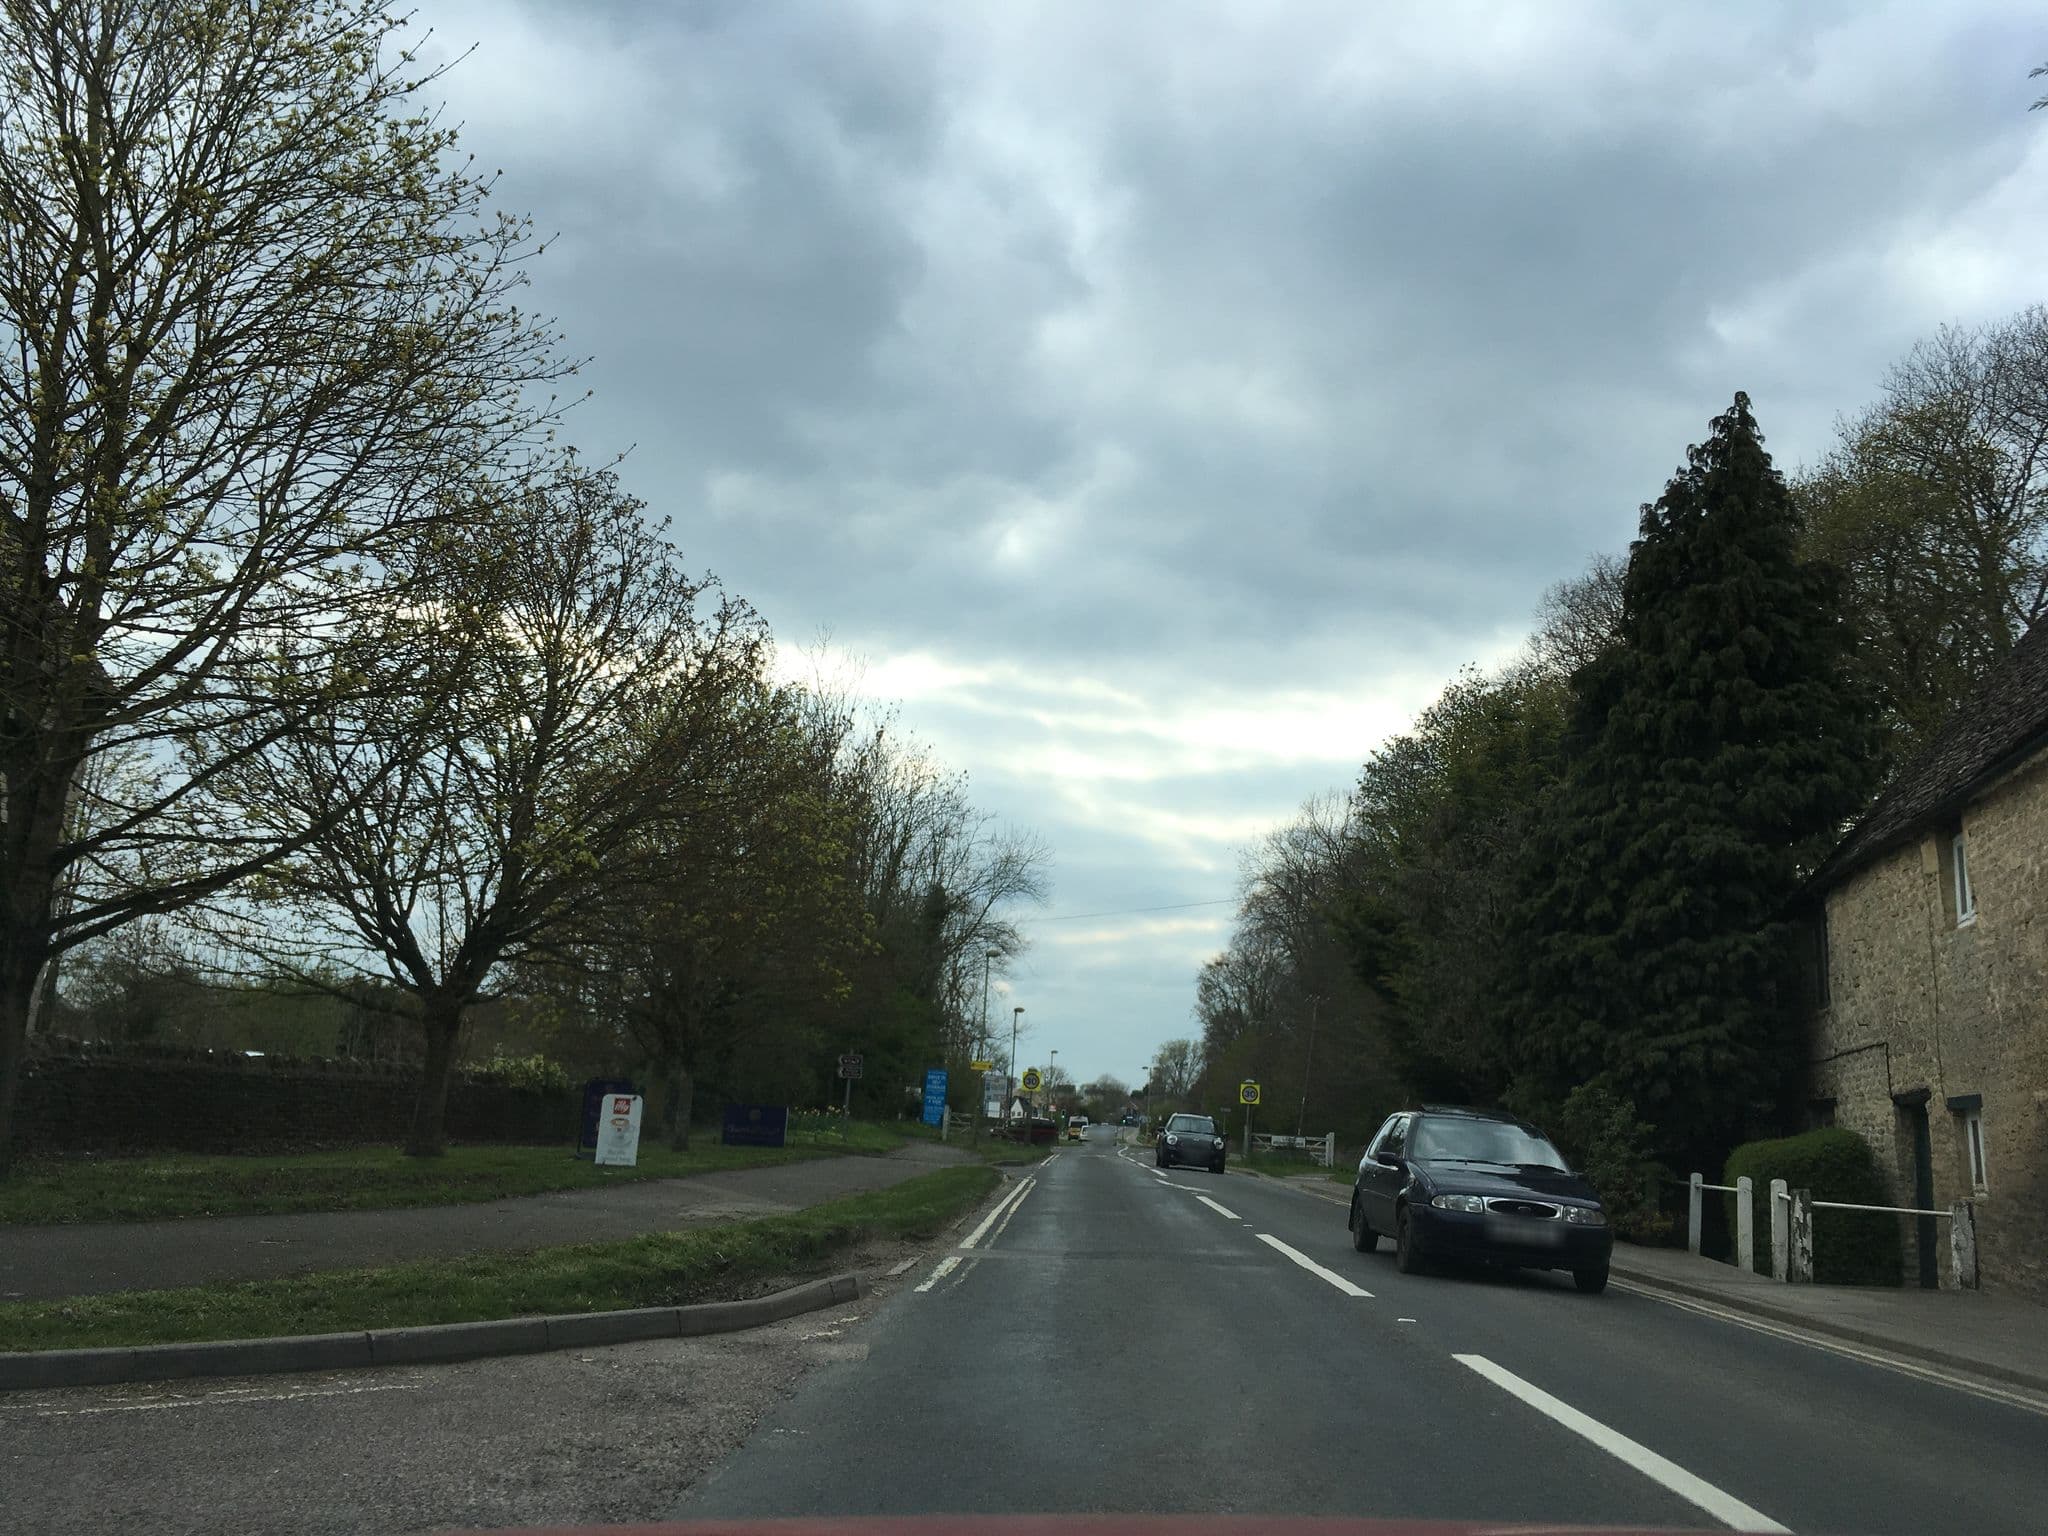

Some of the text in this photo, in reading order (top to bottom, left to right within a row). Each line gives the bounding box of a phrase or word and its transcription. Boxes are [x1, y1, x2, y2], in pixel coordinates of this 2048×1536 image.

[1026, 1077, 1037, 1085] 30
[1244, 1090, 1255, 1098] 30
[614, 1100, 629, 1113] illy
